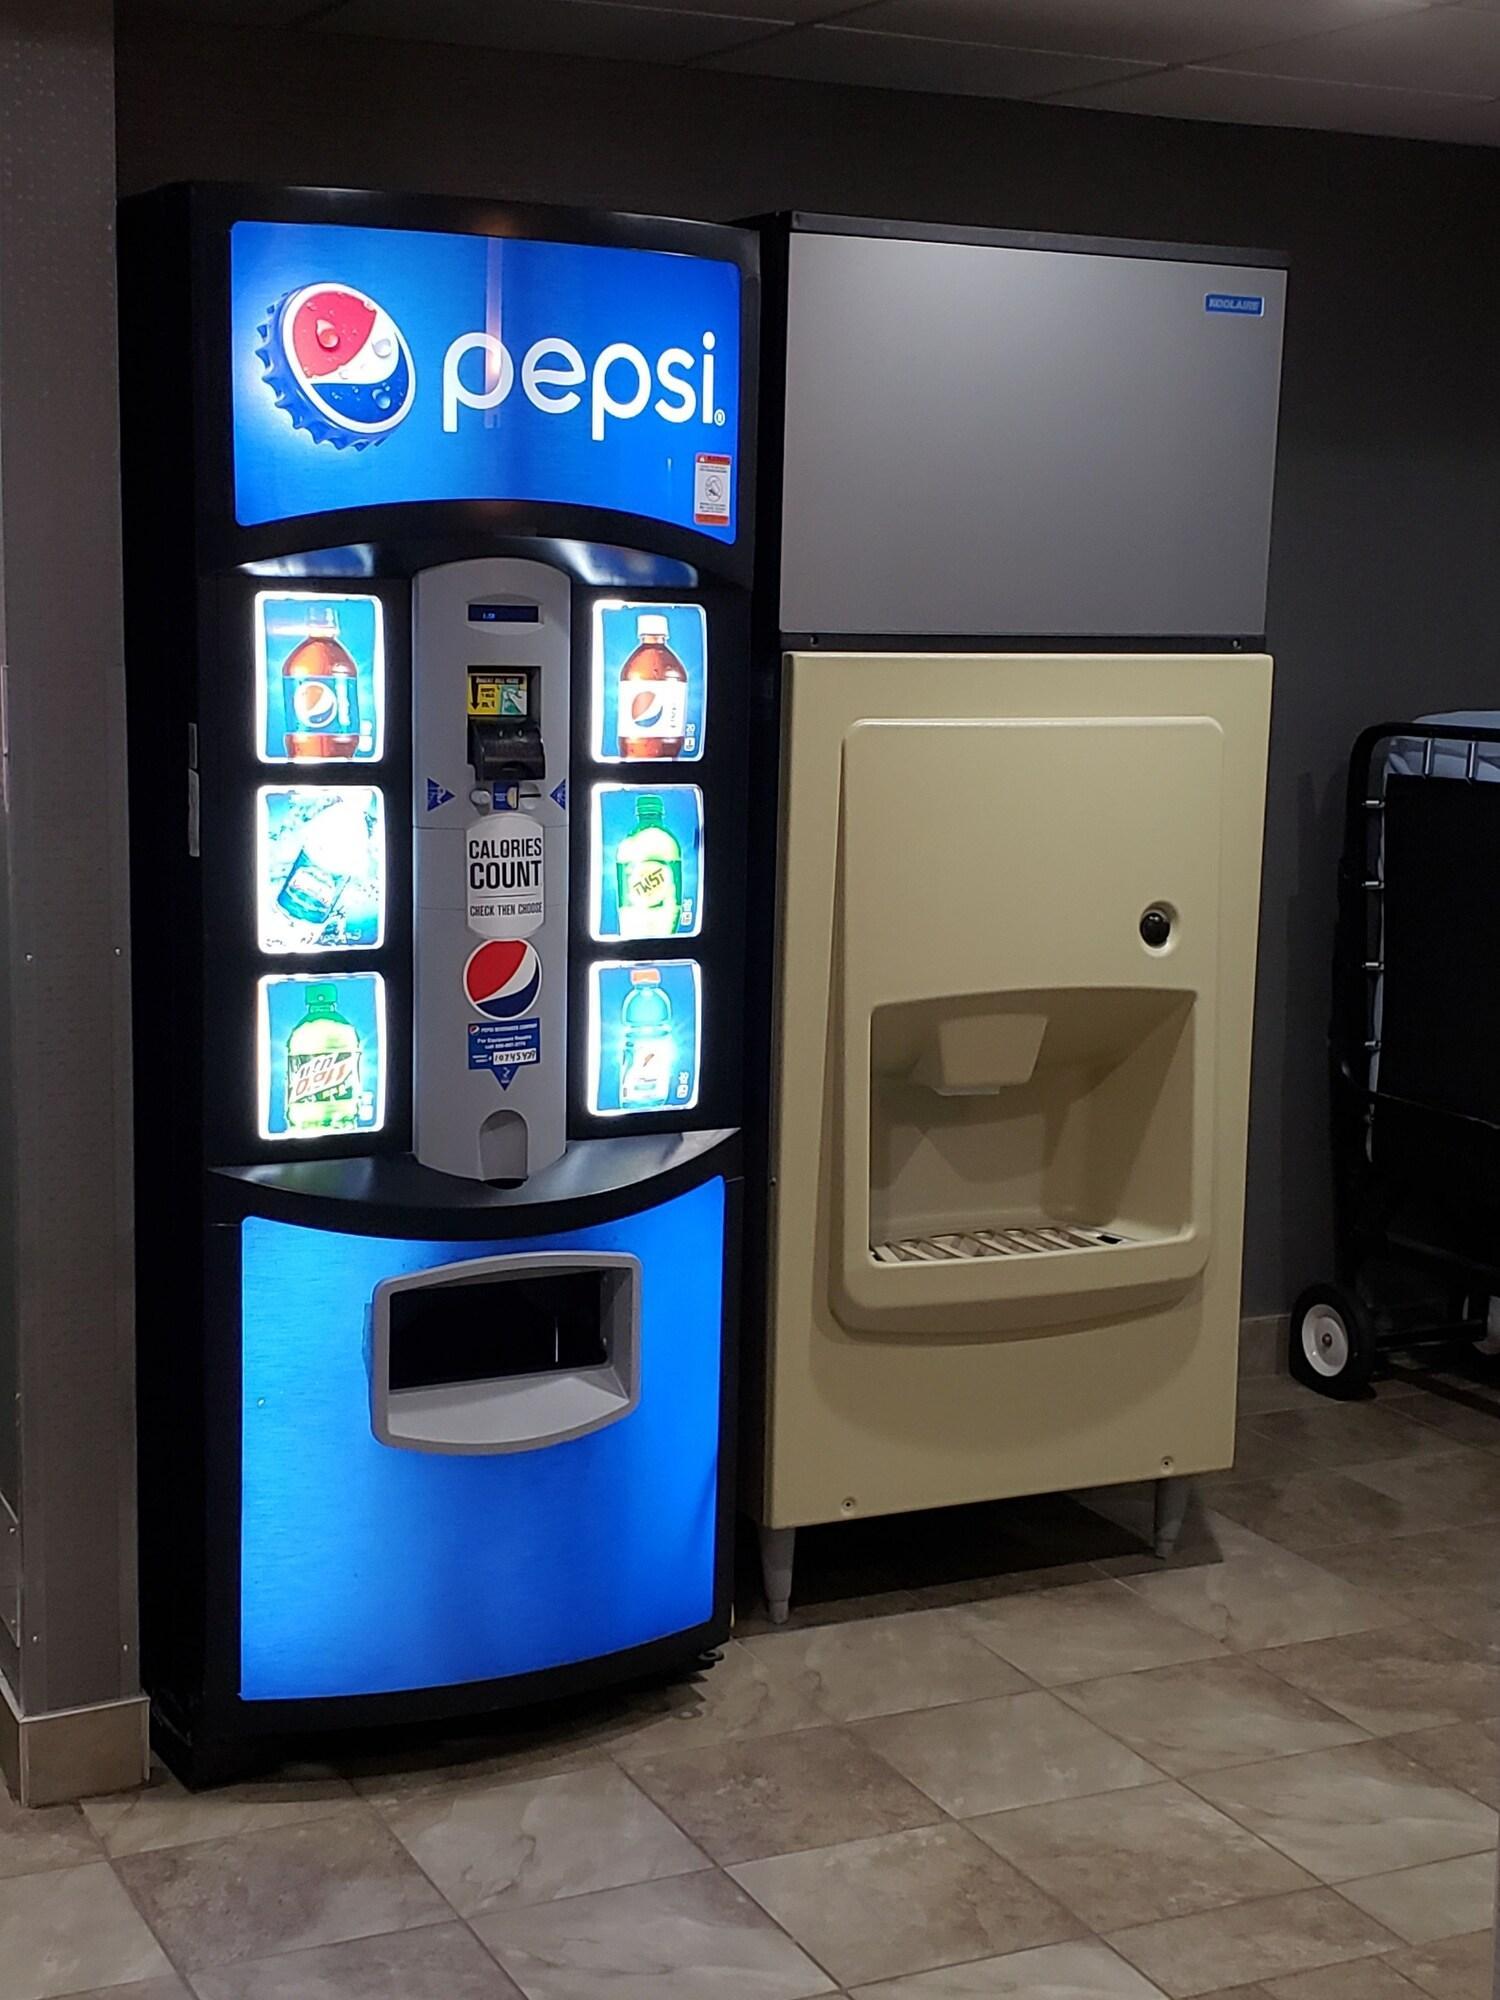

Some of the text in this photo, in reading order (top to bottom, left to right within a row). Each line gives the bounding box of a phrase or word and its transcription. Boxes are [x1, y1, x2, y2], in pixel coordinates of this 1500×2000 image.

[443, 331, 712, 441] pepsi
[469, 838, 542, 859] CALORIES
[470, 860, 542, 889] COUNT
[633, 868, 665, 896] TWIST
[470, 905, 495, 917] CHECK
[497, 904, 516, 916] THEN
